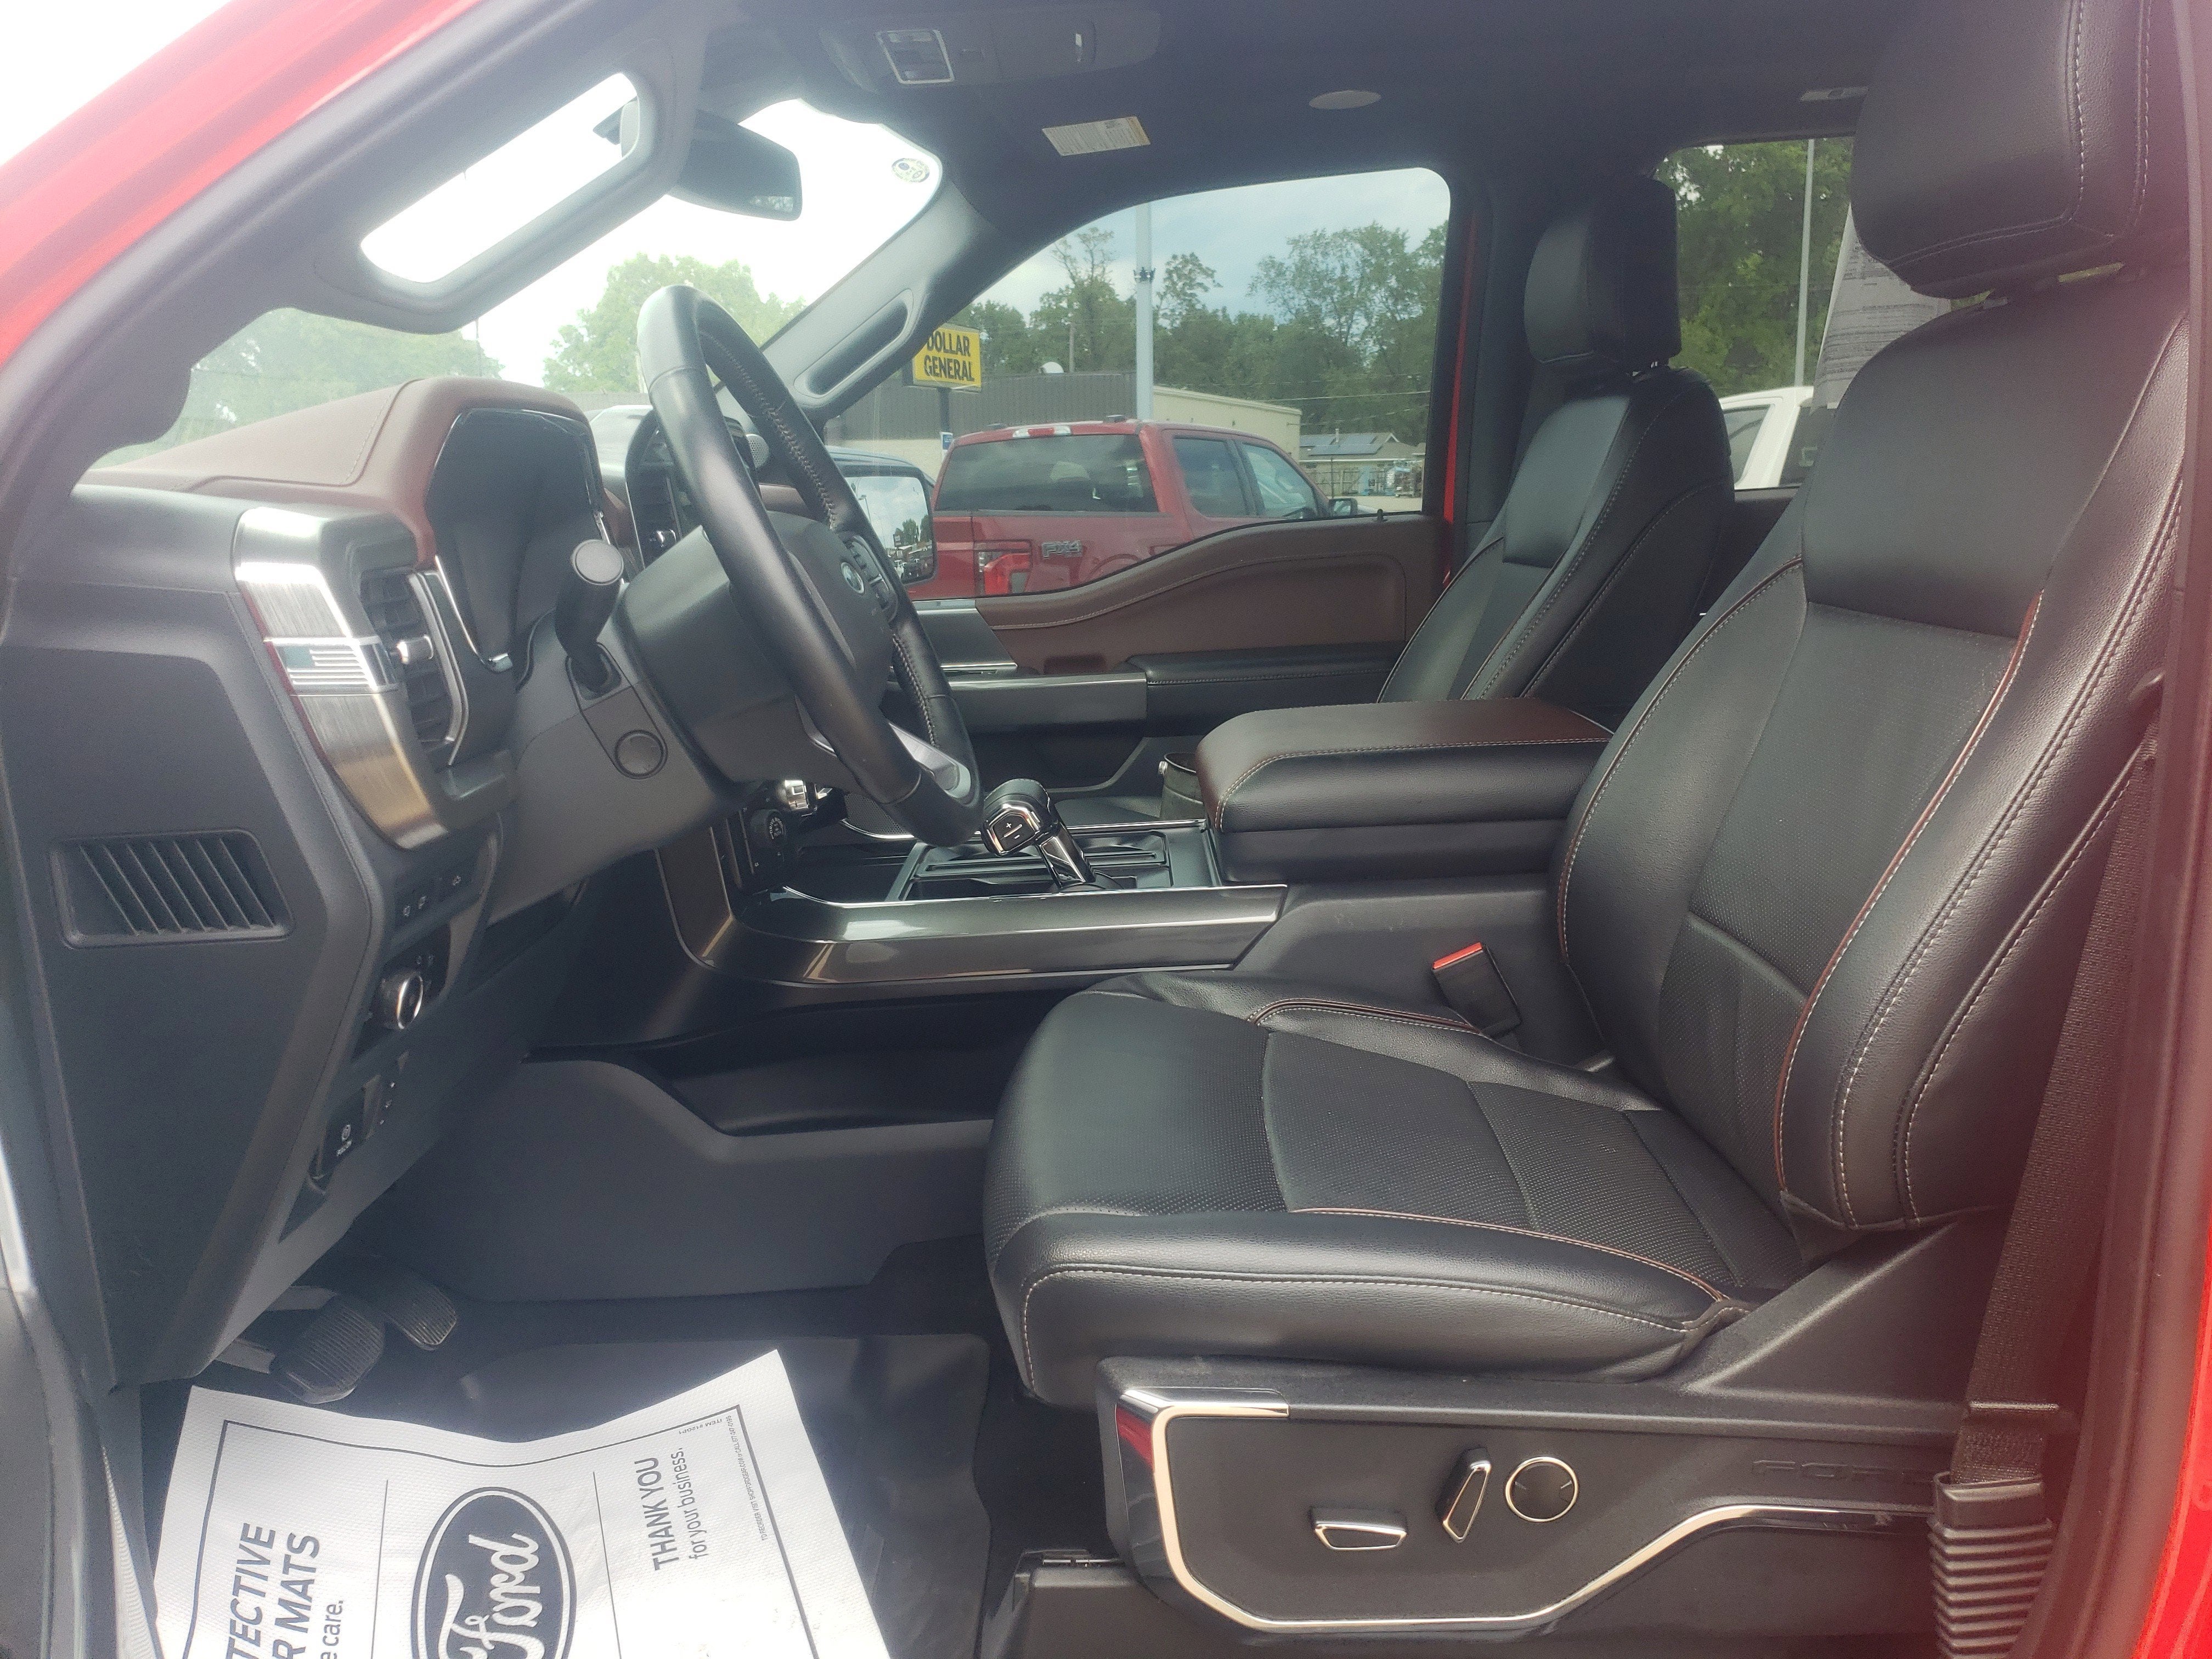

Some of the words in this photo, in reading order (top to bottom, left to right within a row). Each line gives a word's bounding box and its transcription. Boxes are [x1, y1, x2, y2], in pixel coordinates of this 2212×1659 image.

[927, 331, 970, 357] DOLLAR
[924, 354, 974, 382] GENERAL
[1042, 540, 1082, 559] FX4
[634, 1457, 664, 1500] YOU
[670, 1447, 696, 1508] business.
[642, 1498, 680, 1571] THANK
[684, 1508, 708, 1538] your
[689, 1539, 709, 1560] for
[274, 1532, 320, 1634] MATS
[438, 1532, 545, 1659] Ford
[322, 1600, 344, 1646] care.
